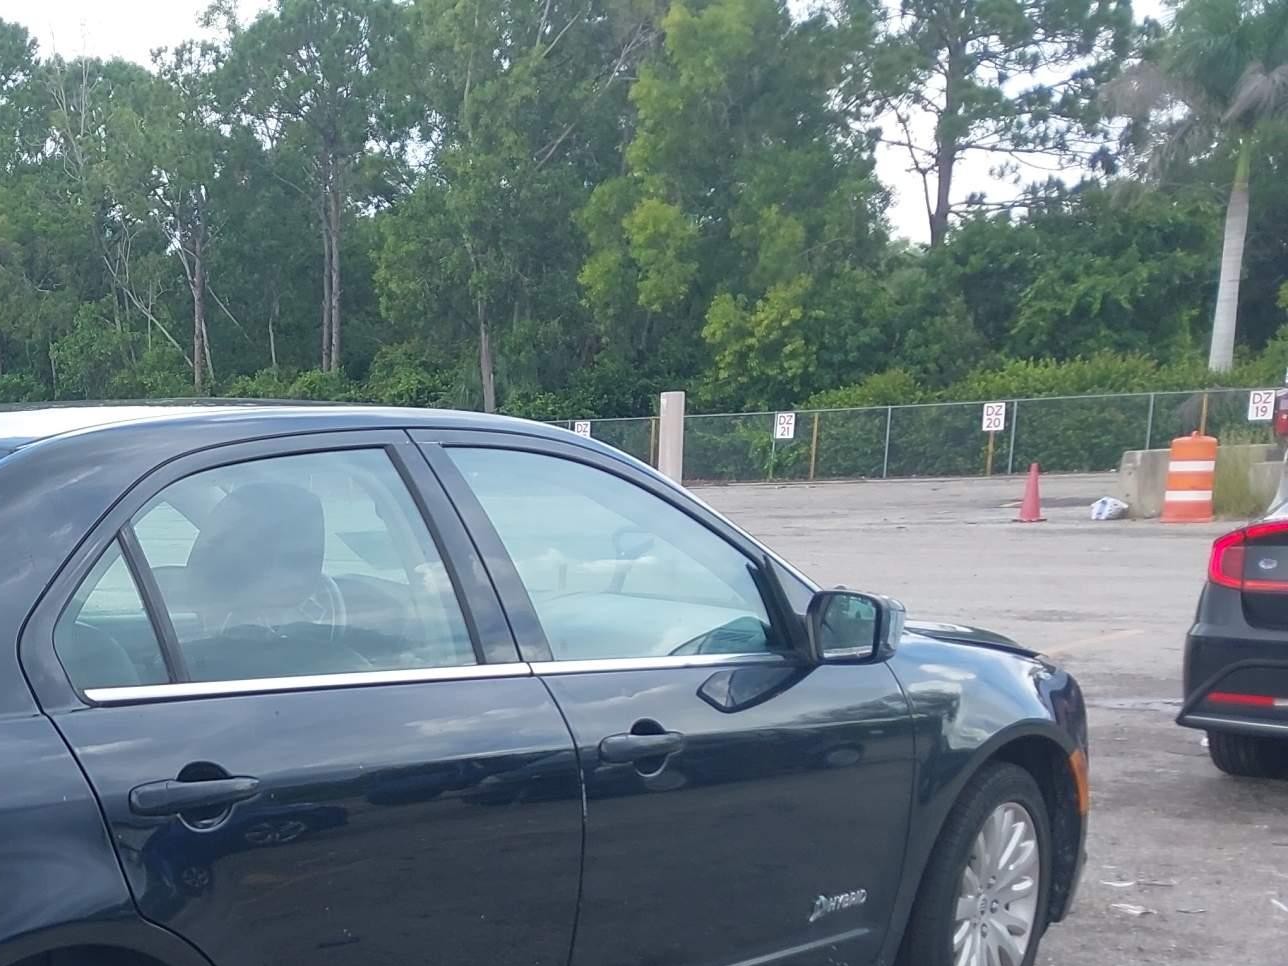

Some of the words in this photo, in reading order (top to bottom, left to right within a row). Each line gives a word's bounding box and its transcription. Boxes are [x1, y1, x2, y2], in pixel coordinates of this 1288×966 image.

[1252, 392, 1273, 404] DZ
[986, 405, 1003, 416] DZ
[1255, 405, 1268, 417] 19
[778, 415, 793, 425] DZ
[986, 417, 1000, 428] 20
[576, 423, 588, 433] DZ
[780, 426, 790, 436] 21
